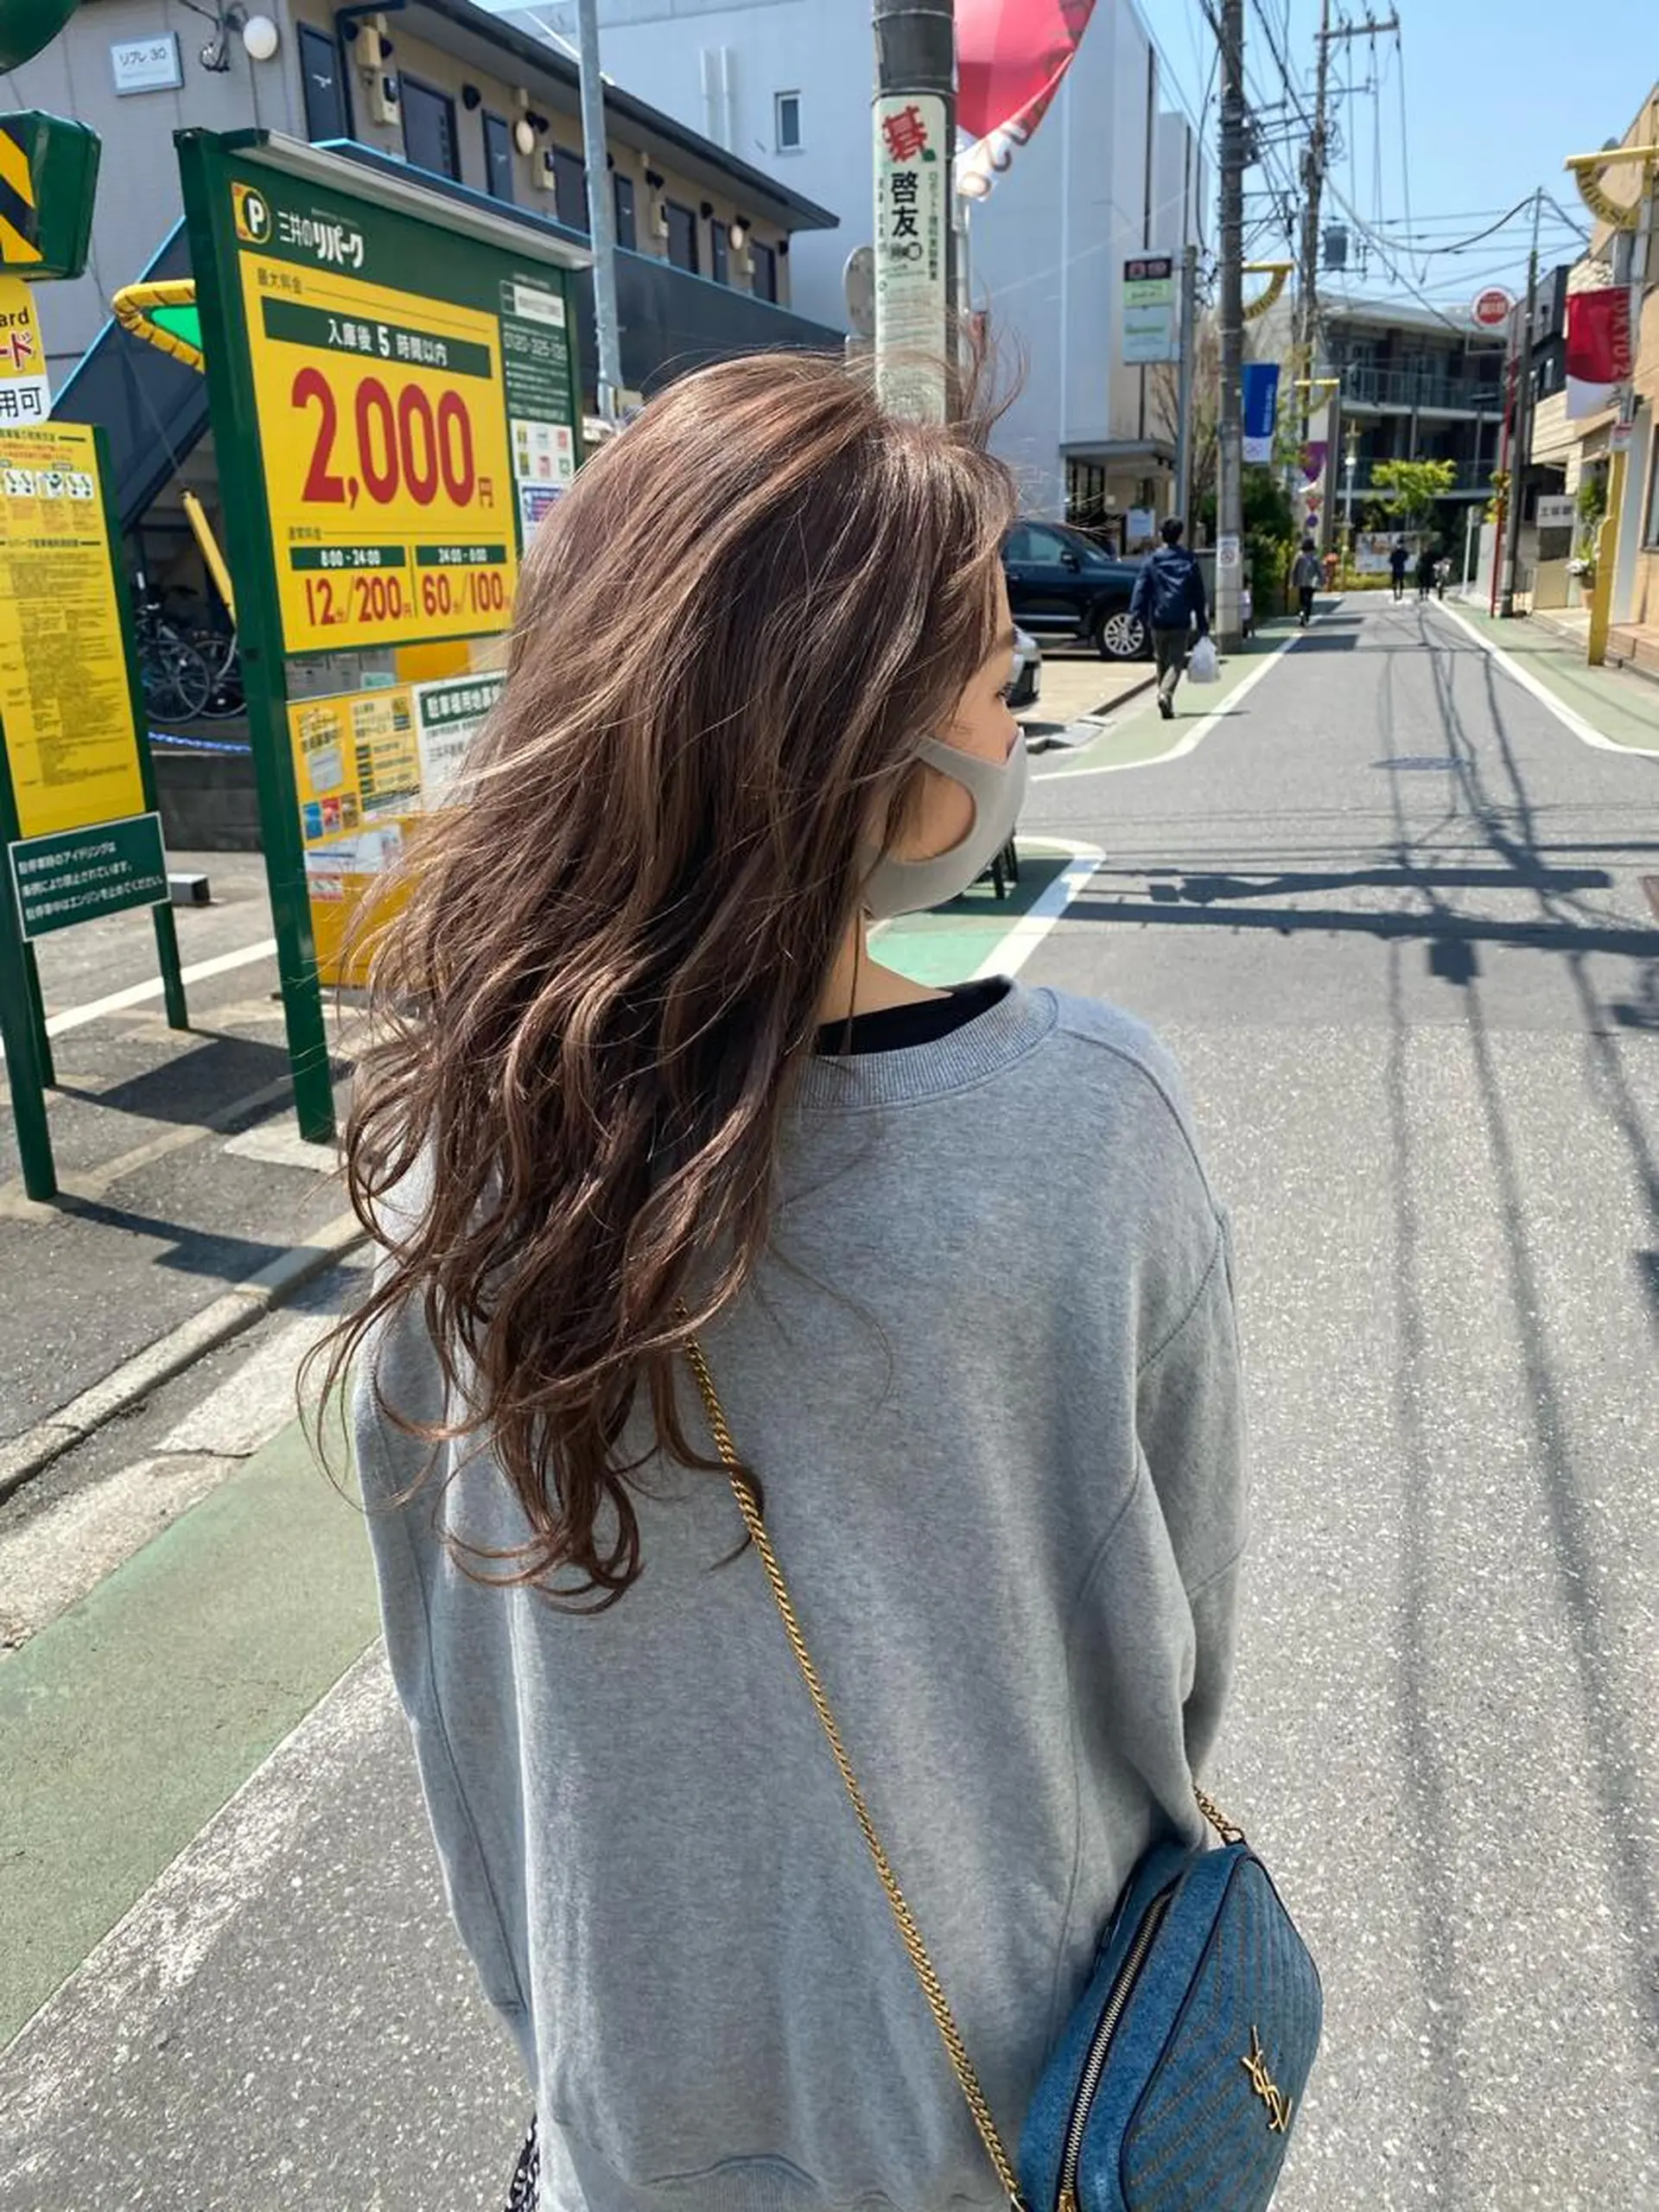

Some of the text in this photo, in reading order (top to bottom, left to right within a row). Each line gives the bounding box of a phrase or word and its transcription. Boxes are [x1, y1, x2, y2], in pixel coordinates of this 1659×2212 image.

[247, 197, 265, 234] P
[891, 170, 918, 238] 啓友
[277, 210, 364, 269] 三井のリパーク
[377, 325, 391, 357] 5
